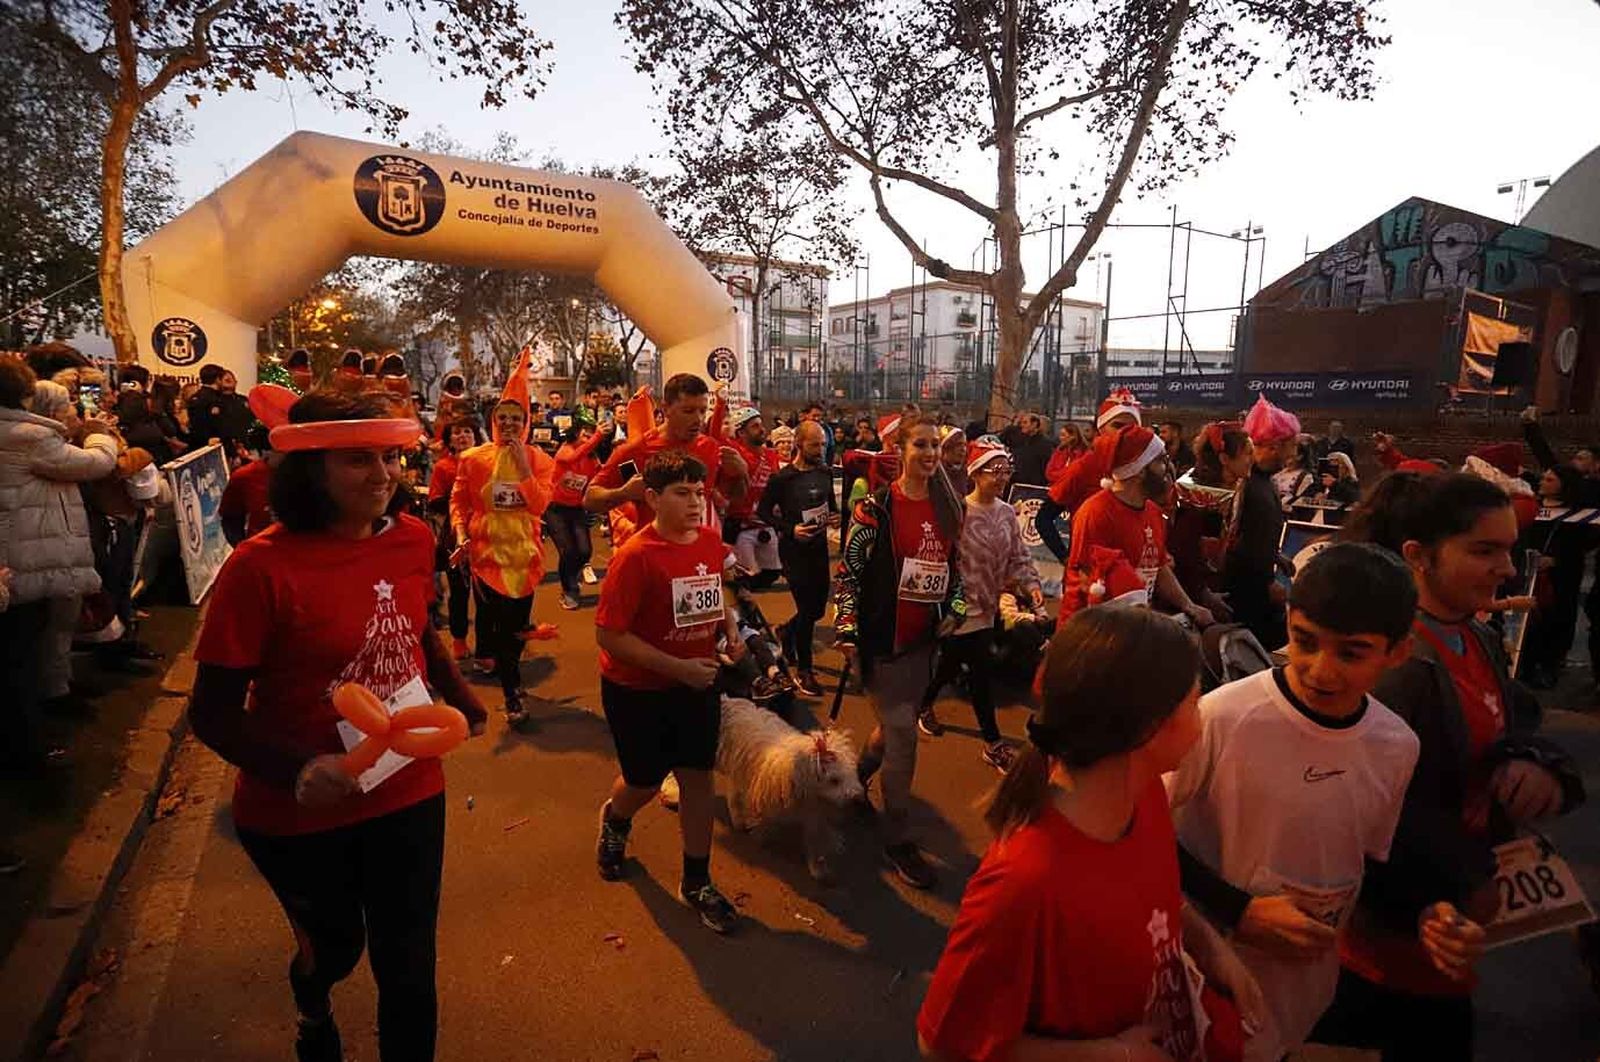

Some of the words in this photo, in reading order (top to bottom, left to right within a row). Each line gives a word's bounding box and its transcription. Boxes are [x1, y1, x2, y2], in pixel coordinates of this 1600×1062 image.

[450, 170, 596, 202] Ayuntamiento
[494, 194, 520, 209] de
[527, 197, 597, 219] Huelva
[528, 217, 543, 227] de
[546, 219, 599, 234] Deportes
[1184, 382, 1225, 391] HYUNDAI
[1266, 380, 1315, 390] HYUNDAI
[1351, 380, 1409, 390] HYUNDAI
[923, 574, 946, 591] 381
[696, 588, 720, 610] 380
[1496, 865, 1565, 911] 208
